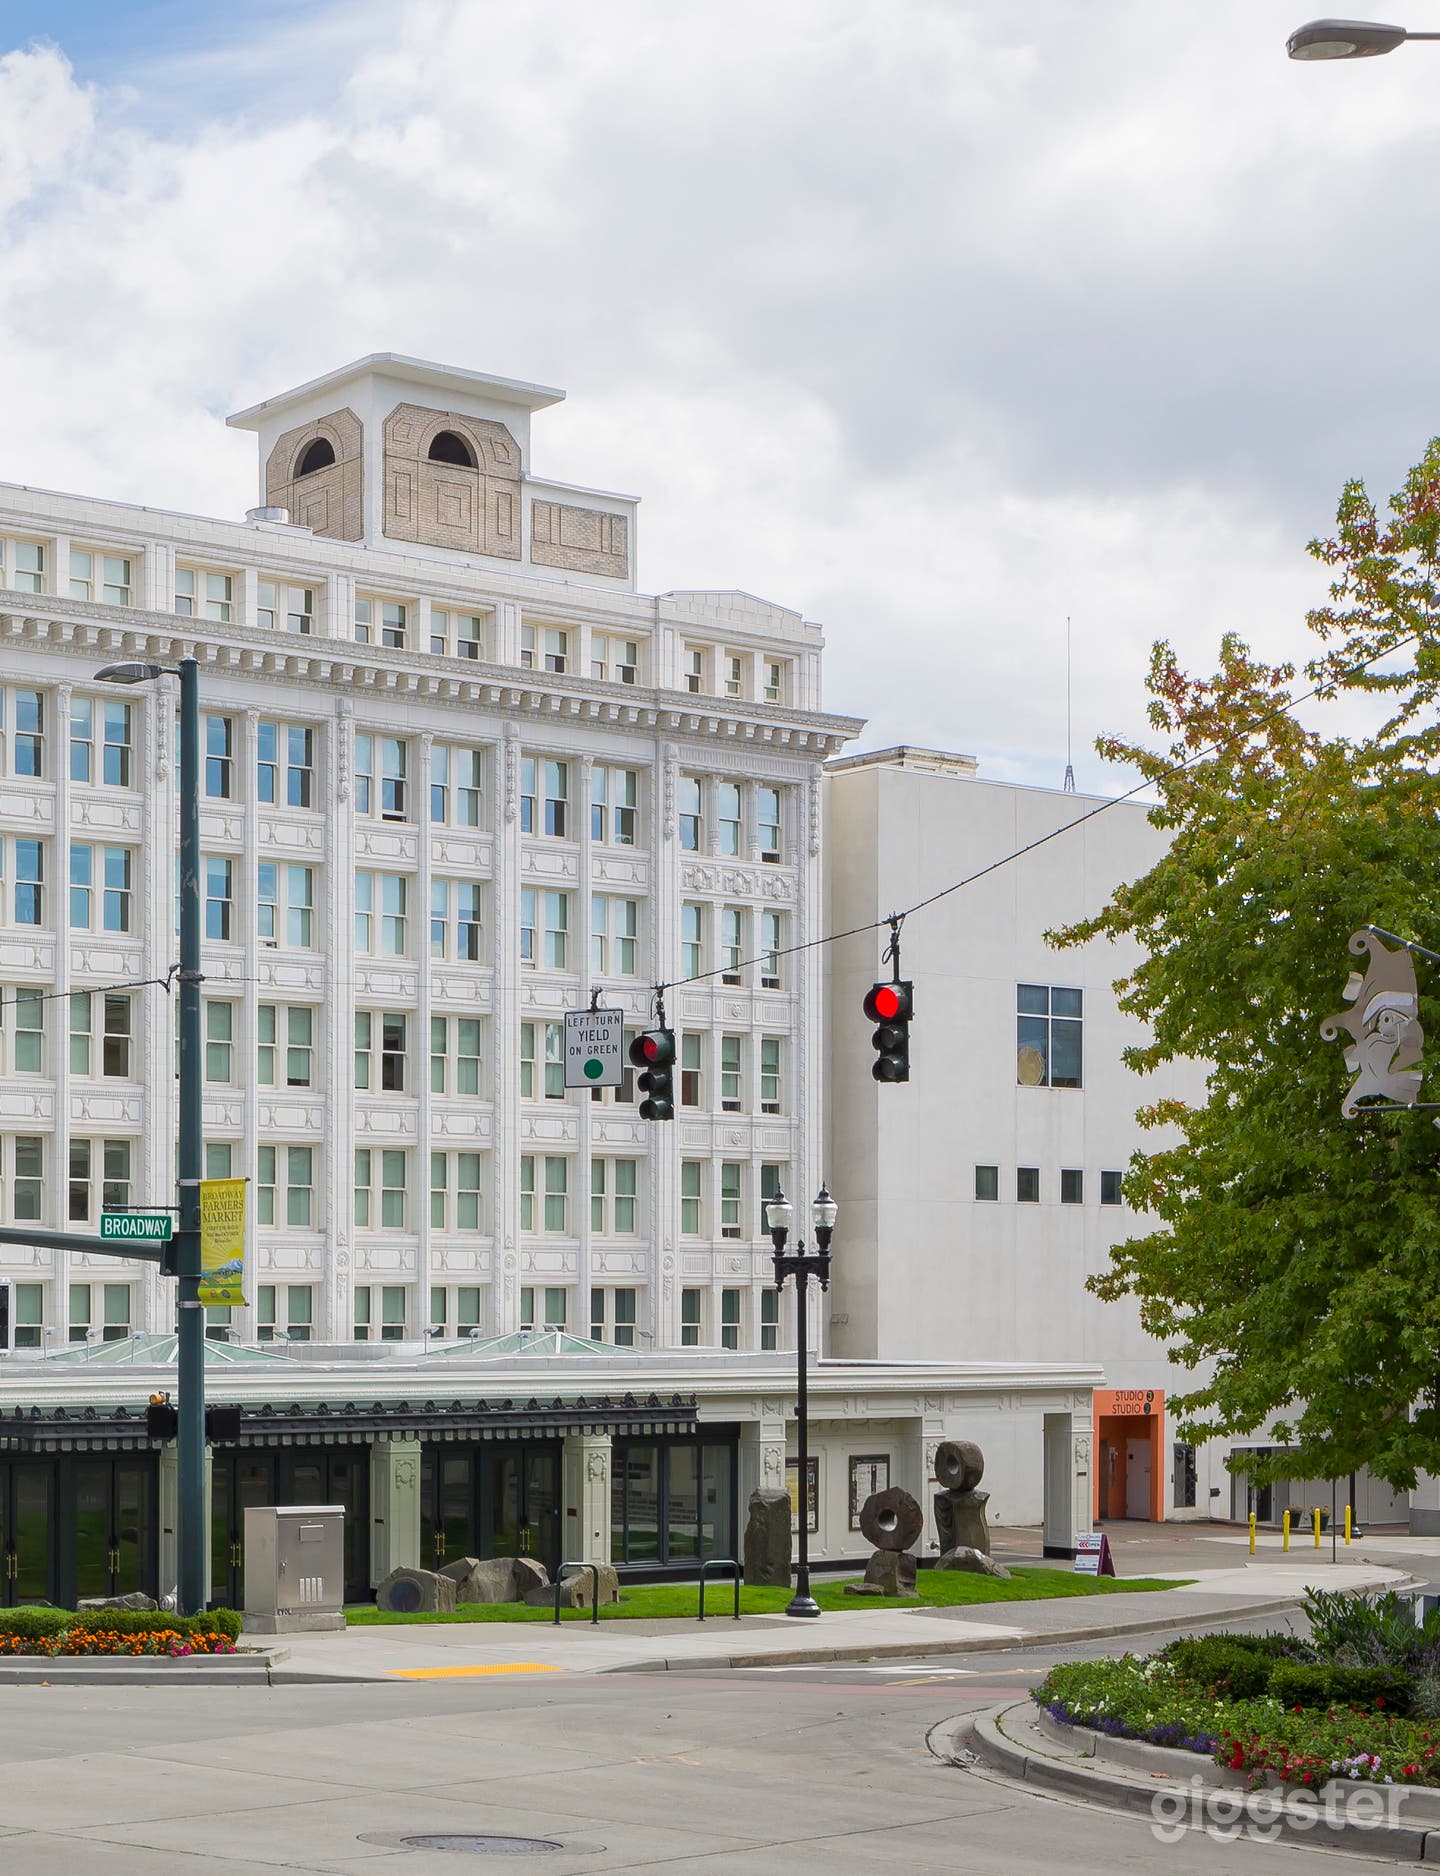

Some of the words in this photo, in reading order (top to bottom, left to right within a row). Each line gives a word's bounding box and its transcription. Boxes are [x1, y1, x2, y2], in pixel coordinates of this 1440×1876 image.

[568, 1017, 589, 1027] LEFT
[596, 1015, 620, 1025] TURN
[578, 1029, 610, 1042] YIELD
[569, 1046, 581, 1056] ON
[587, 1044, 618, 1055] GREEN
[202, 1191, 242, 1200] BROADWAY
[203, 1200, 243, 1211] FARMERS
[202, 1211, 243, 1222] MARKET
[104, 1218, 167, 1236] BROADWAY
[1115, 1391, 1144, 1402] STUDIO
[1112, 1404, 1141, 1414] STUDIO
